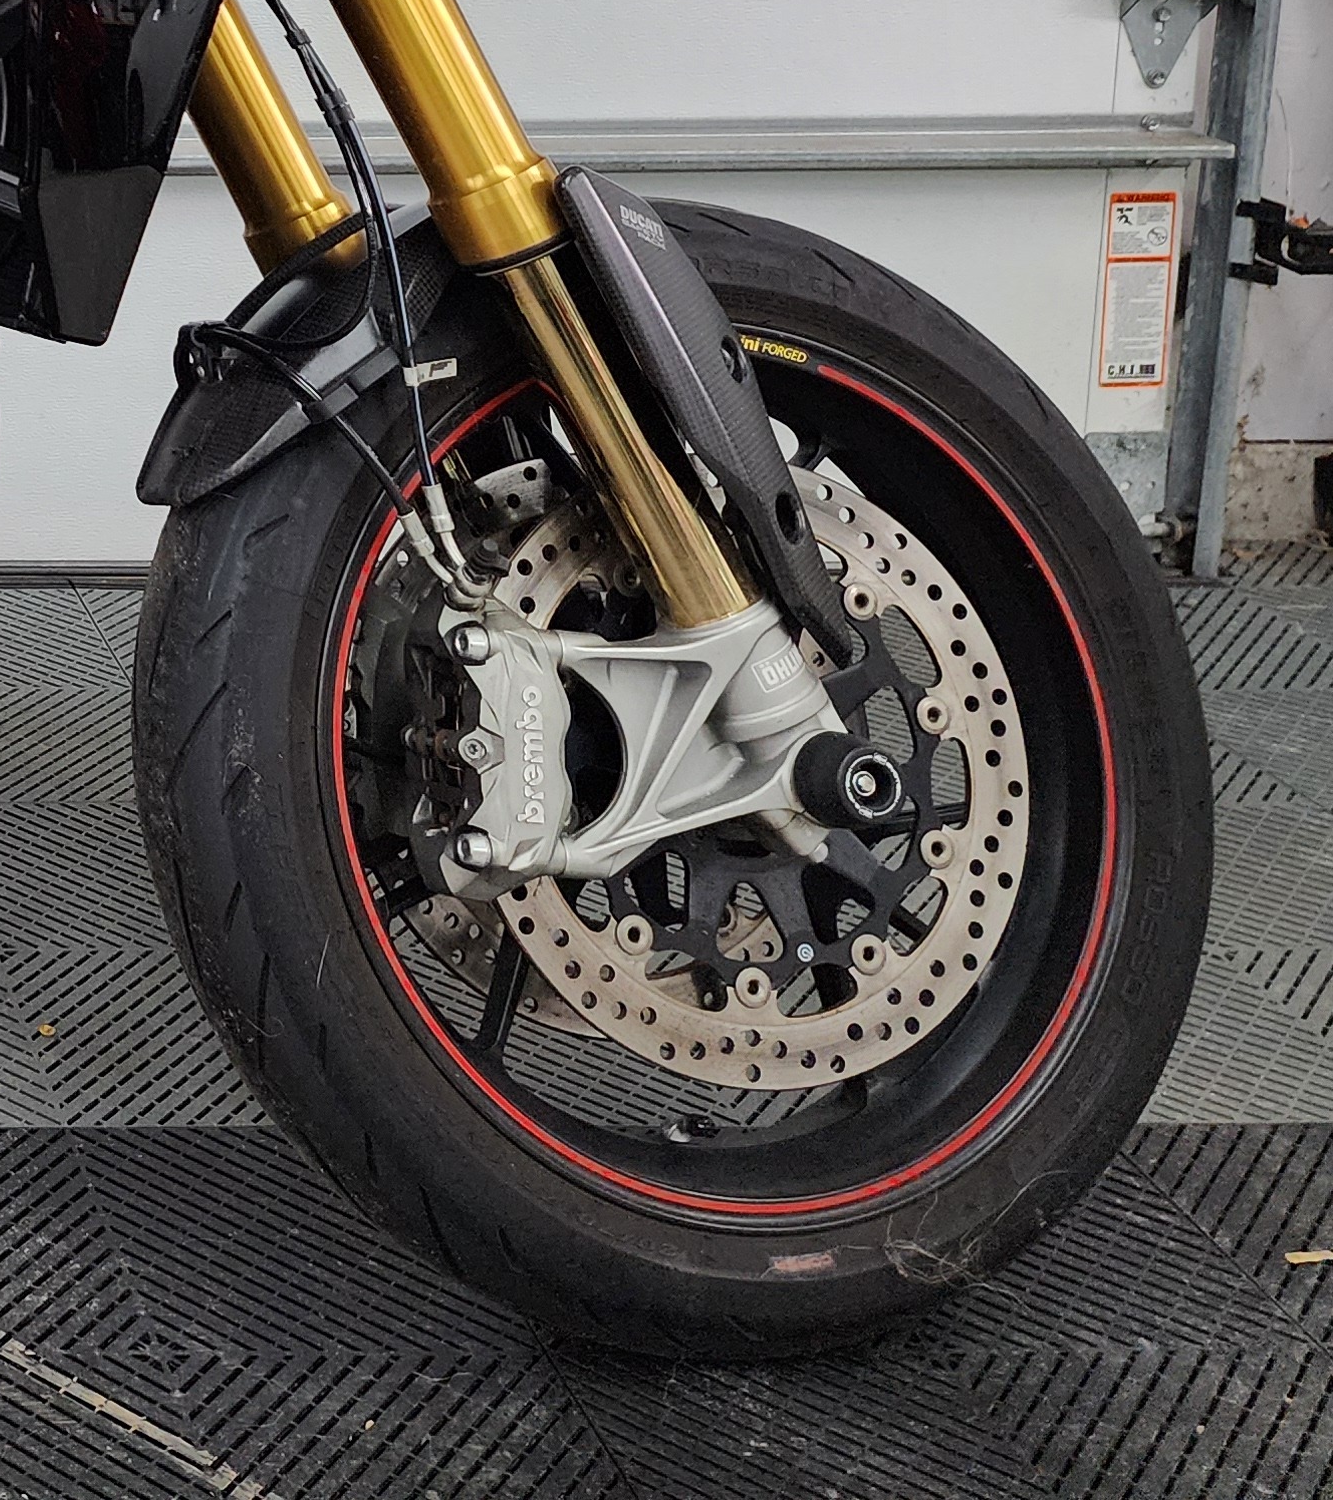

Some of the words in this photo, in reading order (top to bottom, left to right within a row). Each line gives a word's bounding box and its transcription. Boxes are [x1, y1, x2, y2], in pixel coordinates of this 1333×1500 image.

[619, 204, 663, 239] DUCATI
[761, 341, 807, 363] FORGED
[514, 684, 545, 825] brembo
